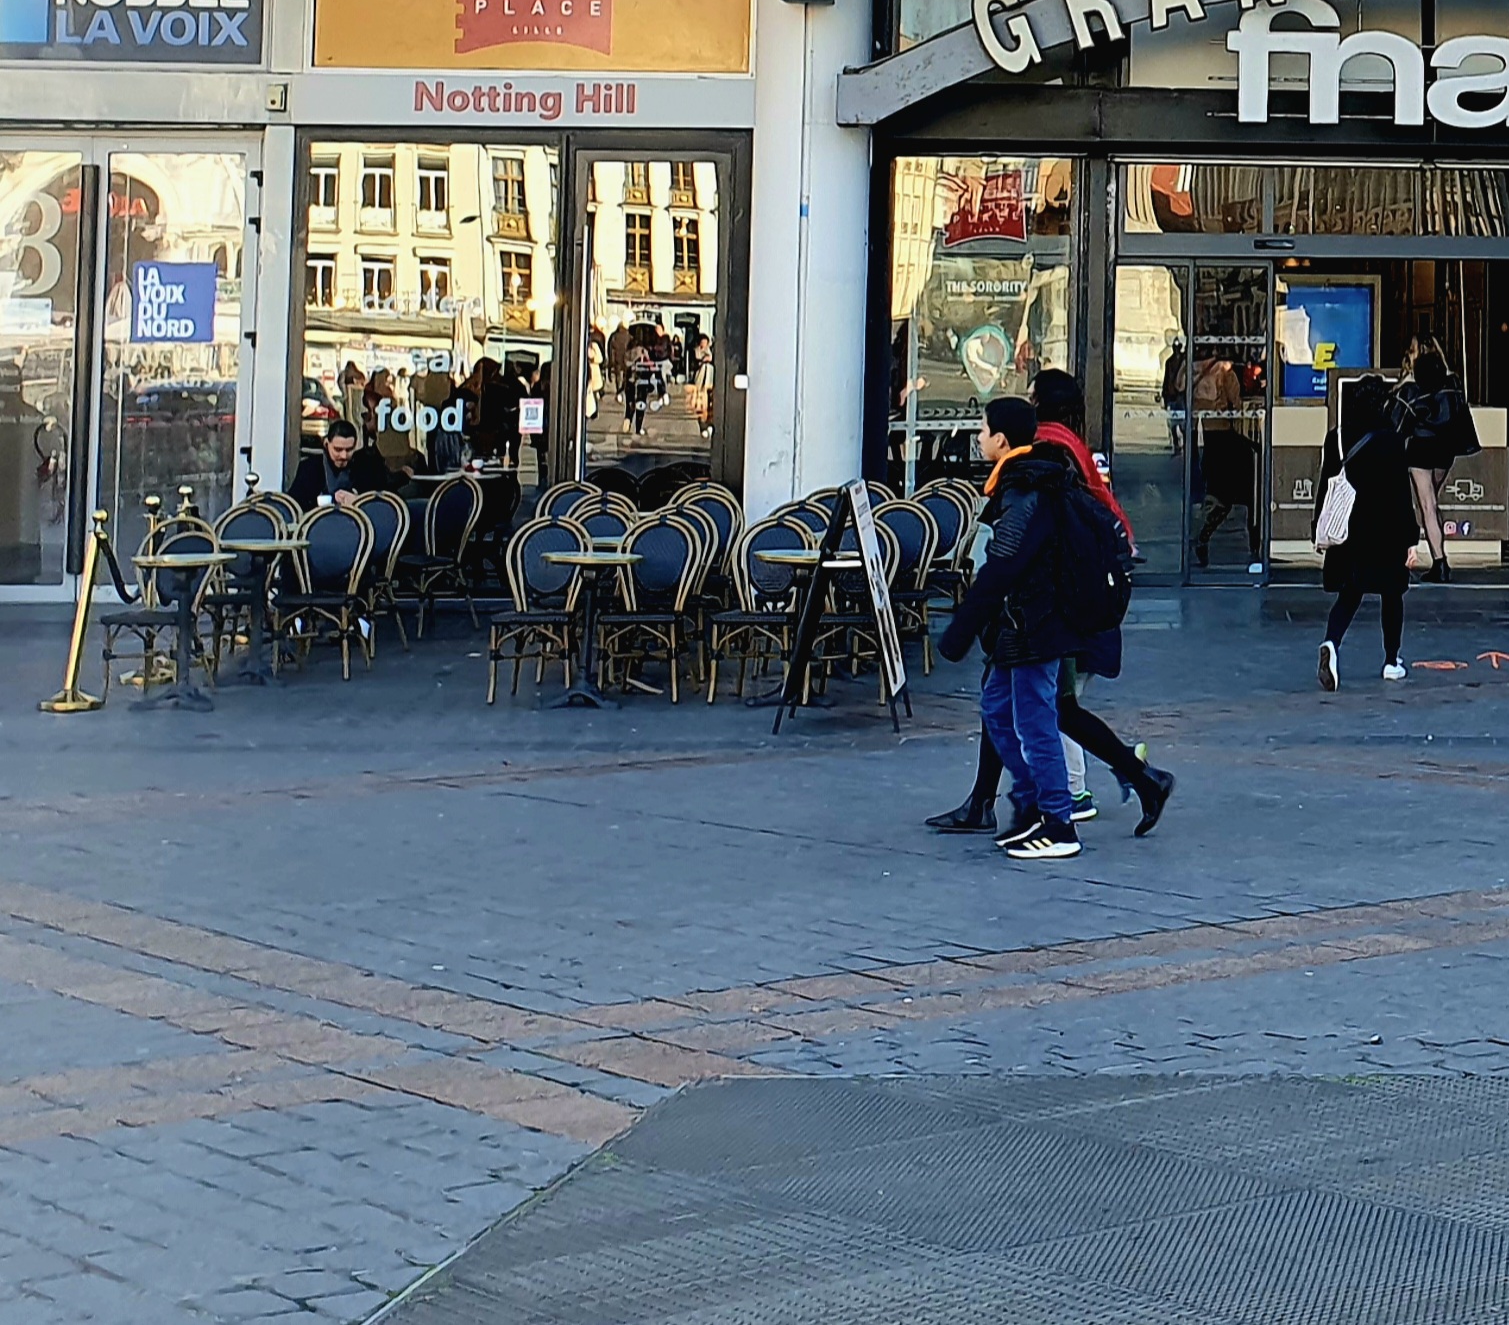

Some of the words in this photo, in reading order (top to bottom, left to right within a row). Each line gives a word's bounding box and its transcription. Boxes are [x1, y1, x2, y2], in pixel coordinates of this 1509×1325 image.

[55, 9, 121, 45] LA
[126, 9, 249, 47] VOIX
[413, 80, 563, 121] Notting
[575, 82, 637, 114] Hill
[137, 266, 160, 286] LA
[971, 280, 1028, 293] SORORITY
[137, 283, 186, 305] VOIX
[138, 302, 167, 321] DU
[137, 319, 196, 339] NORD
[375, 397, 464, 433] food
